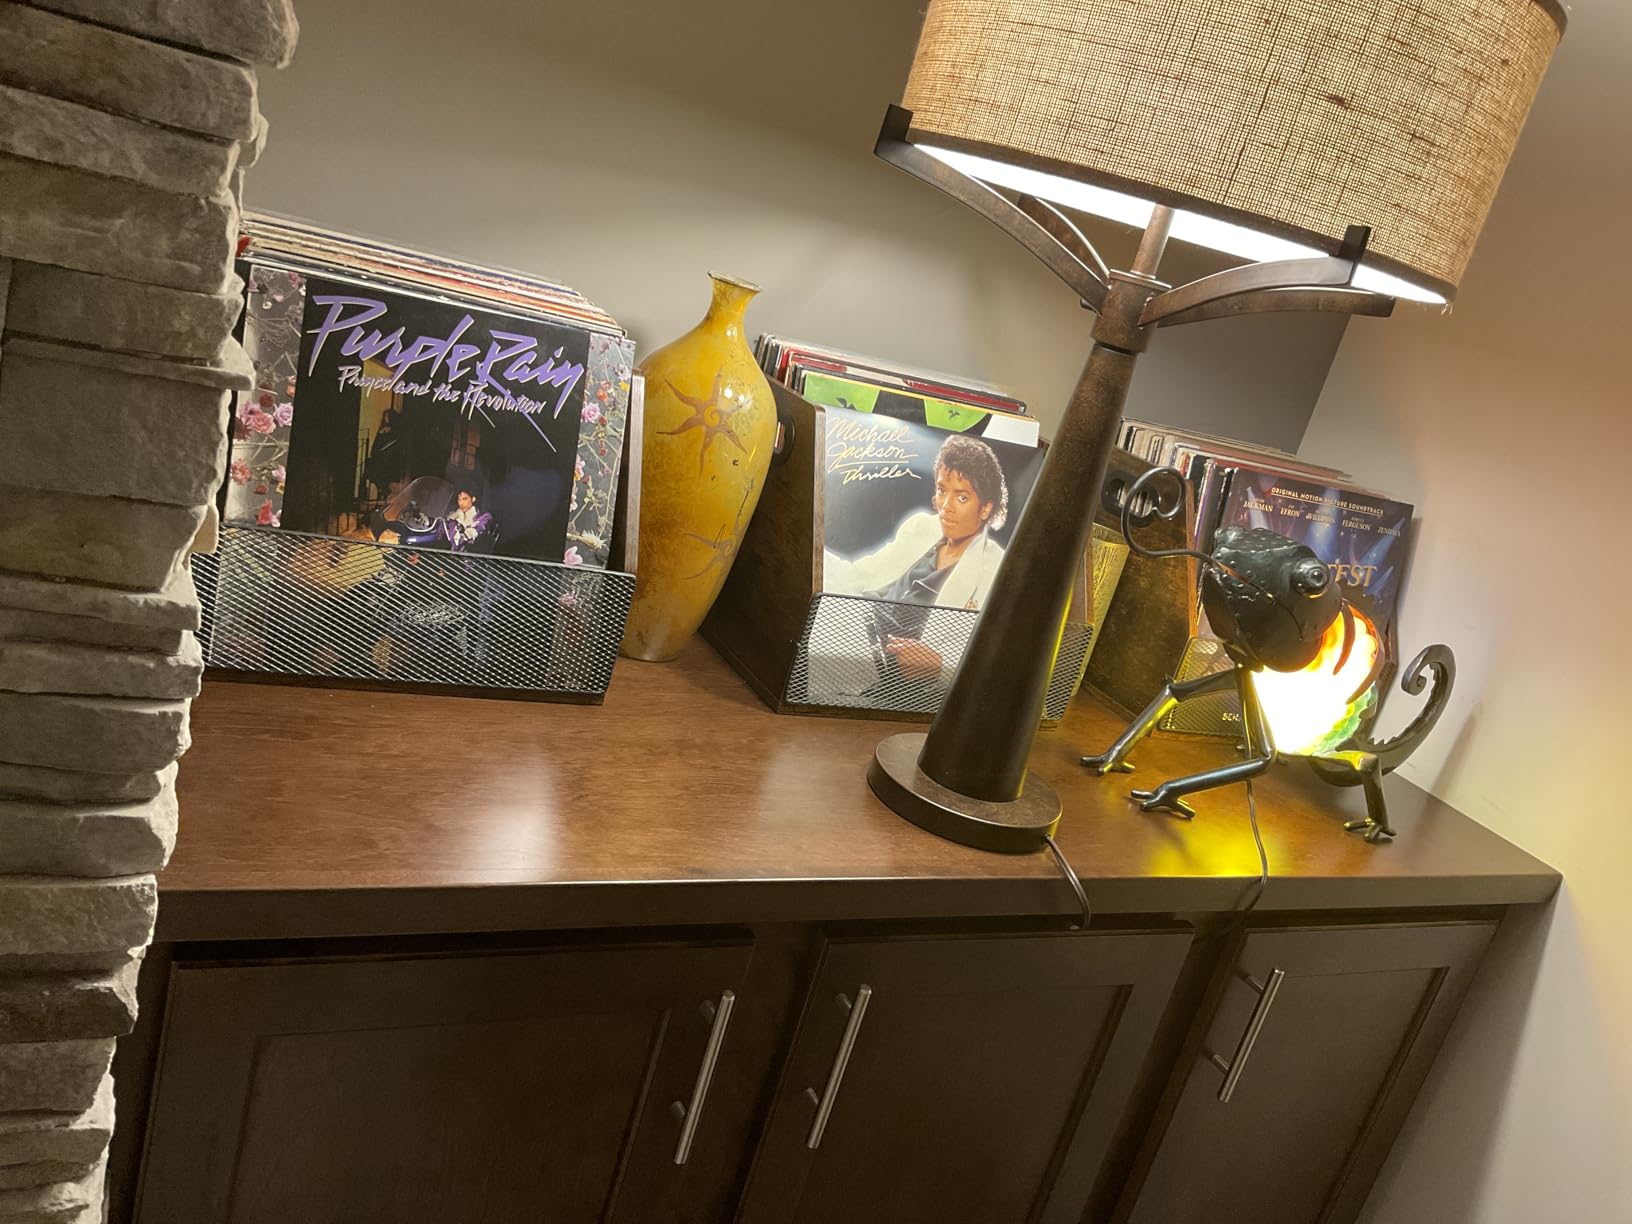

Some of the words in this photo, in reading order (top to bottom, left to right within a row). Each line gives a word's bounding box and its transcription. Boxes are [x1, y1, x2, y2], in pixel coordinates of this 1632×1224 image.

[306, 295, 480, 389] Purple
[476, 329, 585, 452] Rain
[338, 365, 394, 398] Prince
[393, 378, 430, 396] and
[433, 384, 461, 403] the
[460, 379, 547, 428] Revolution
[826, 416, 914, 443] Michael
[826, 440, 918, 473] Jackson
[840, 464, 922, 485] Thriller
[1243, 500, 1274, 512] JACKMAN
[1280, 507, 1300, 518] EFRON
[1342, 519, 1371, 531] FERGUSON
[1271, 487, 1299, 498] ORIGINAL
[1300, 493, 1323, 503] MOTION
[1323, 497, 1348, 508] PICTURE
[1348, 501, 1385, 515] SOUNDTRACK
